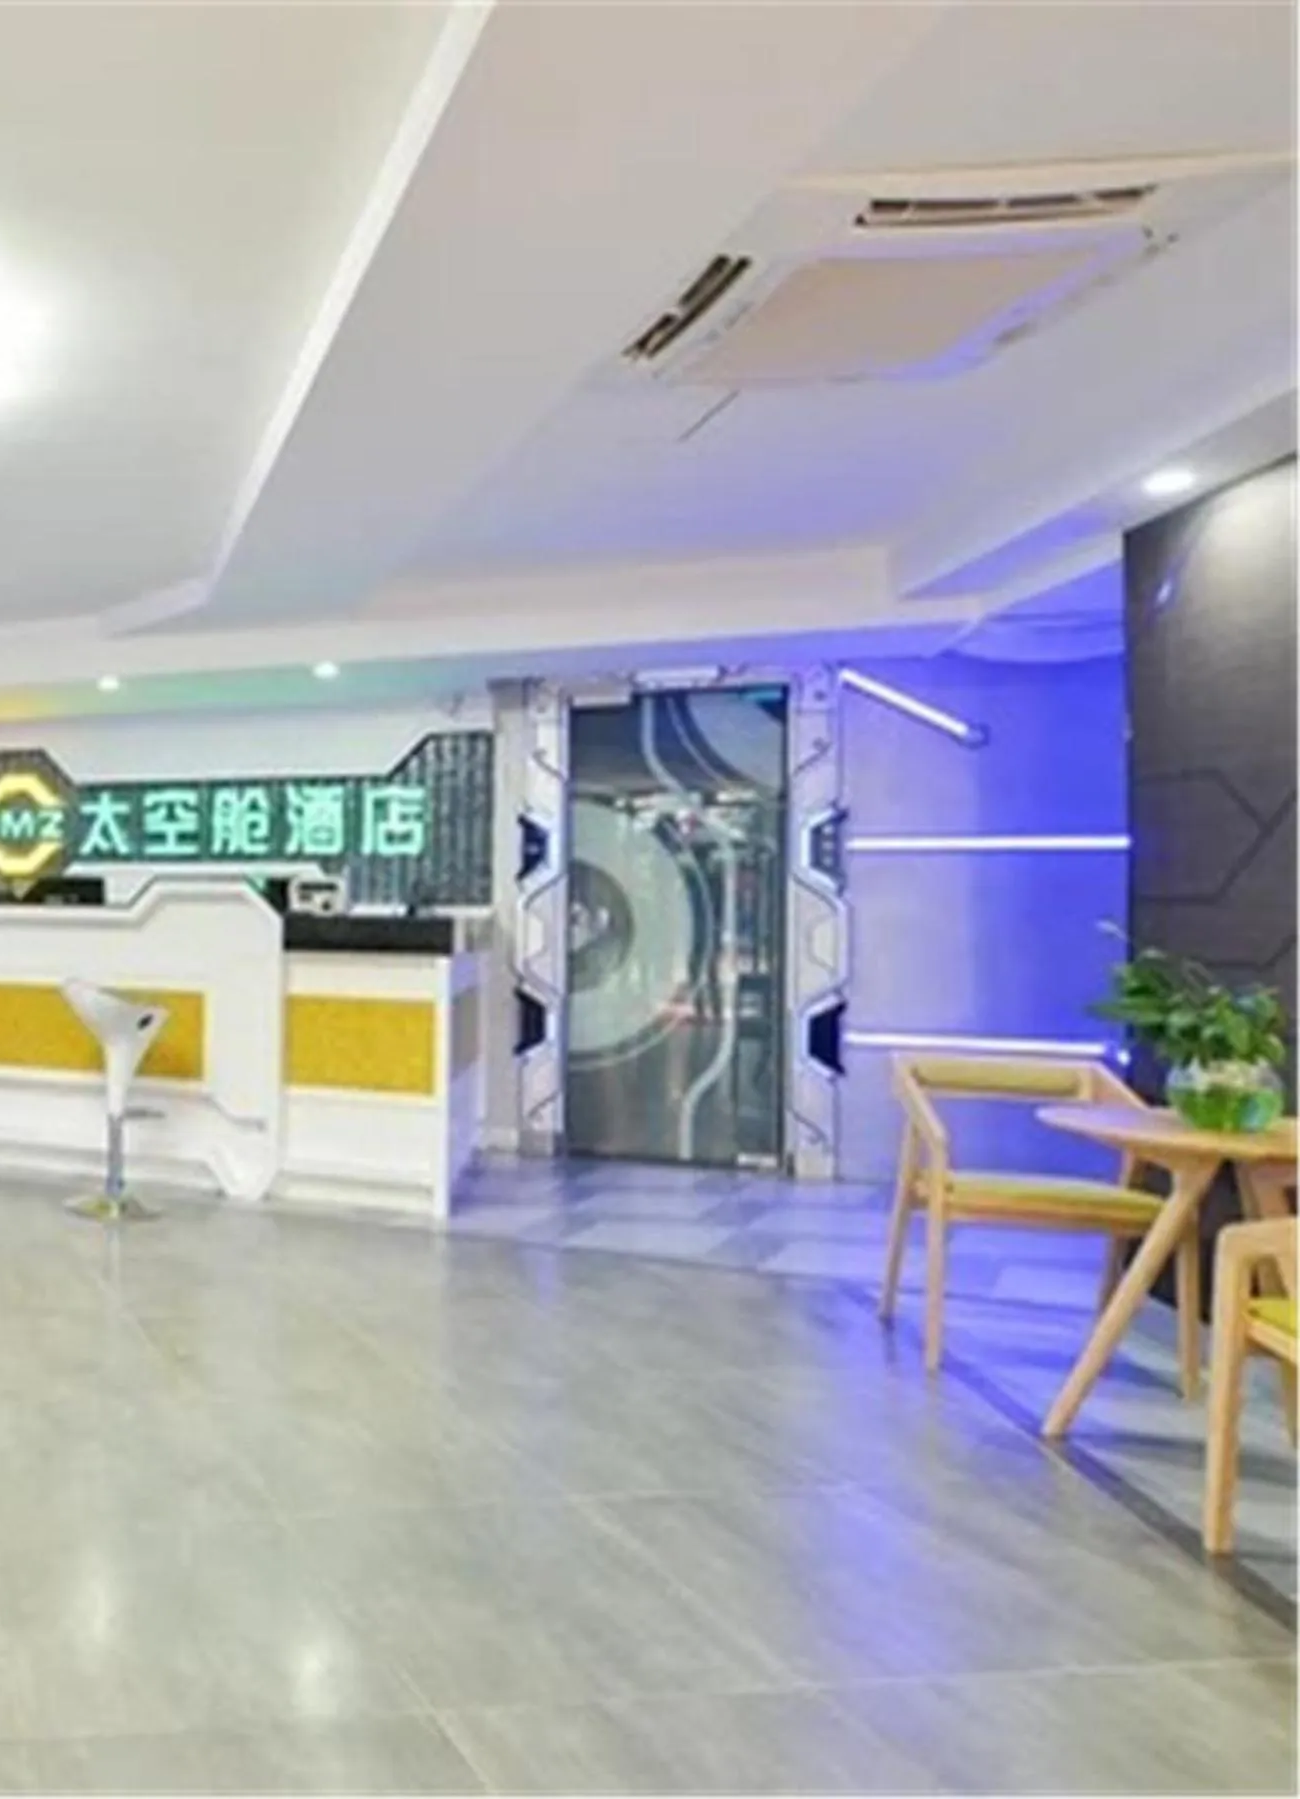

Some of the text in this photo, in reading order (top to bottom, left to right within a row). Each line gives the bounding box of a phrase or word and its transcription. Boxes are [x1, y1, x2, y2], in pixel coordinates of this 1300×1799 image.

[81, 786, 428, 857] 太空舱酒店
